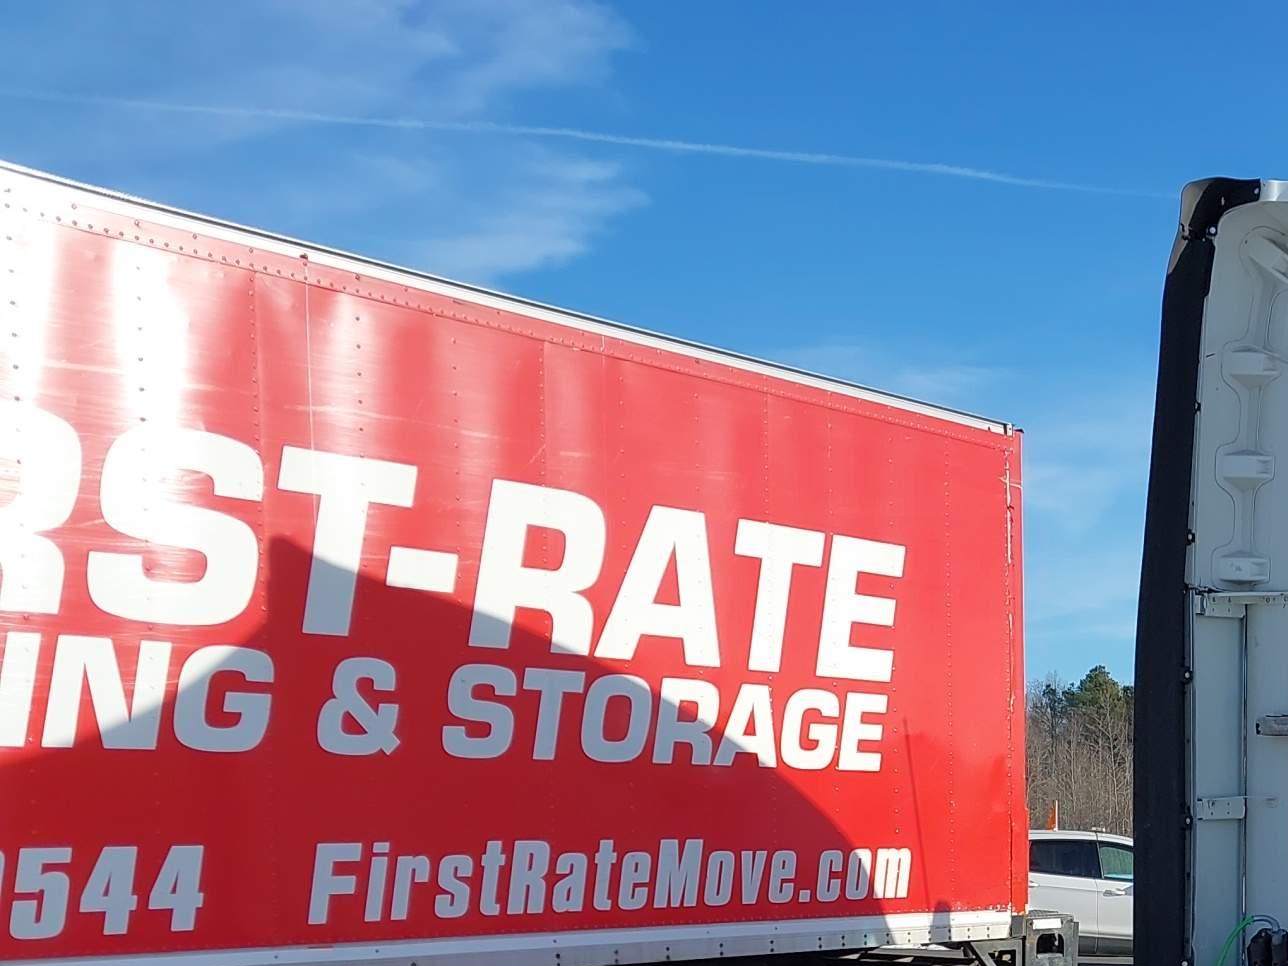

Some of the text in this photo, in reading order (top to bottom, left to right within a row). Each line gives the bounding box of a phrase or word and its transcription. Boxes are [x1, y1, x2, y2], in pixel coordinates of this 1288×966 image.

[316, 656, 401, 756] &
[441, 663, 889, 773] STORAGE
[0, 838, 912, 940] 544 FirstRateMove.com
